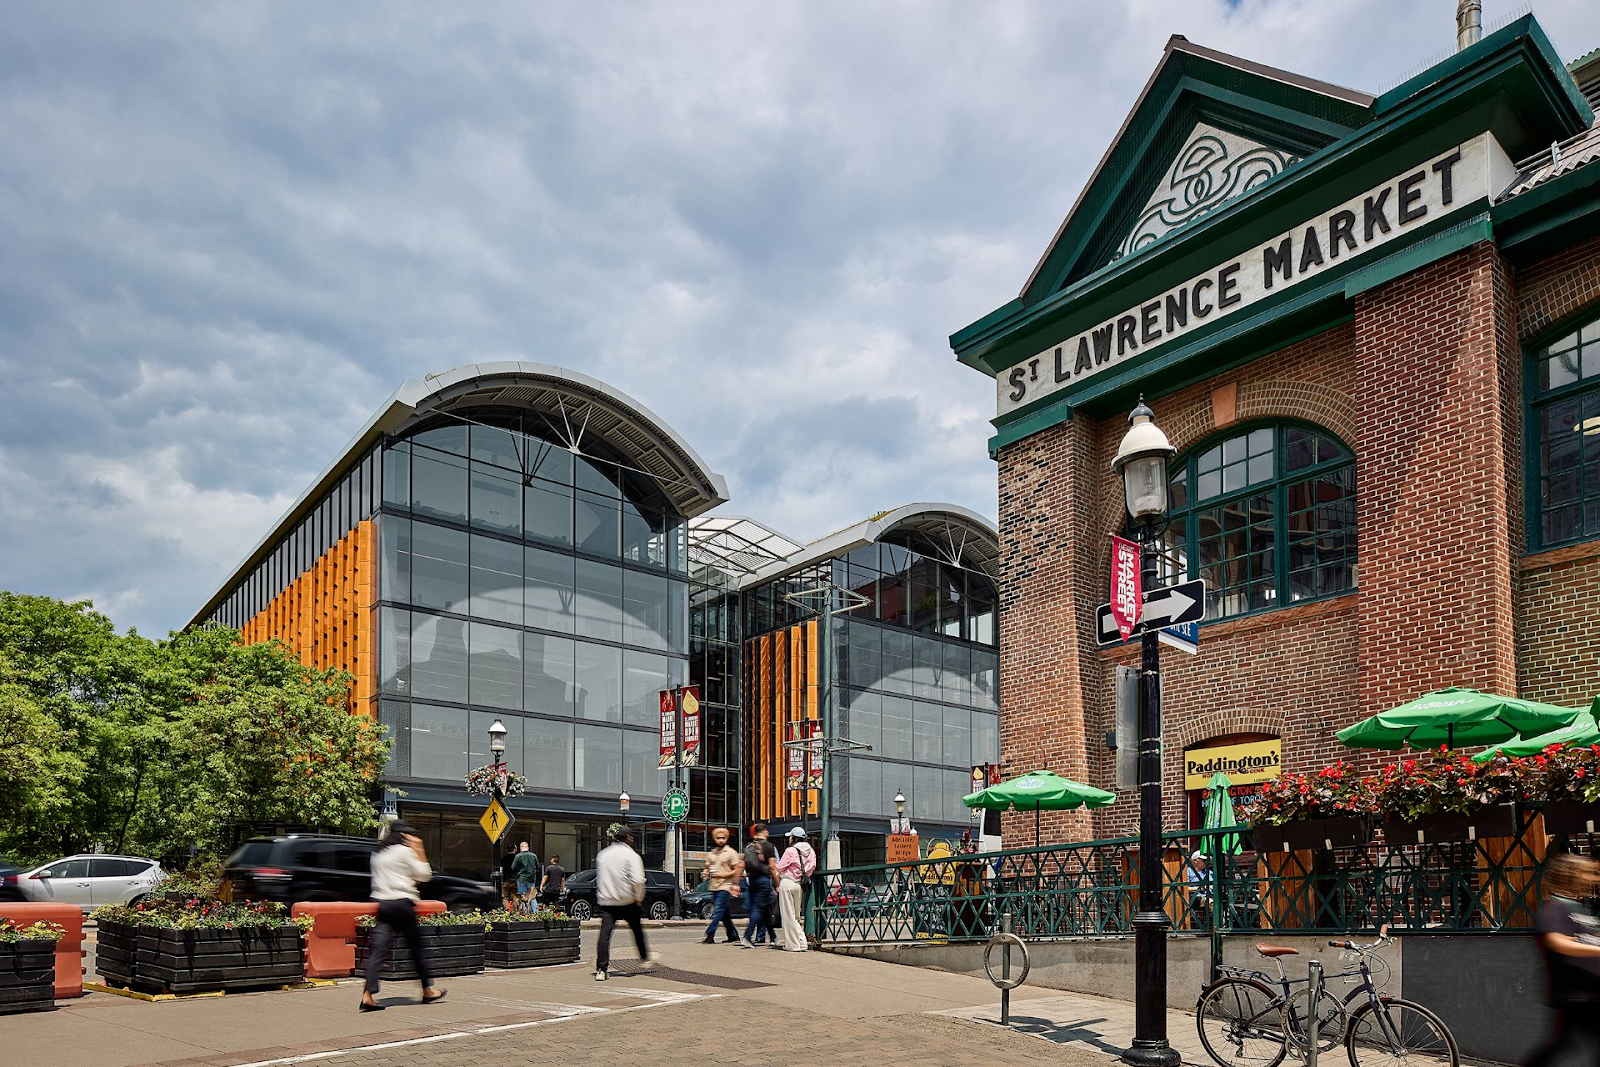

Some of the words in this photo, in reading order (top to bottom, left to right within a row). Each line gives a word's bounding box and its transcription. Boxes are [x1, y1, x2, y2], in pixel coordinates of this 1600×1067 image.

[1054, 262, 1242, 384] LAWRENCE
[1263, 152, 1461, 289] MARKET
[1117, 549, 1127, 617] STREET
[1126, 552, 1136, 626] MARKET
[1187, 751, 1279, 774] Paddington's
[671, 797, 682, 811] P
